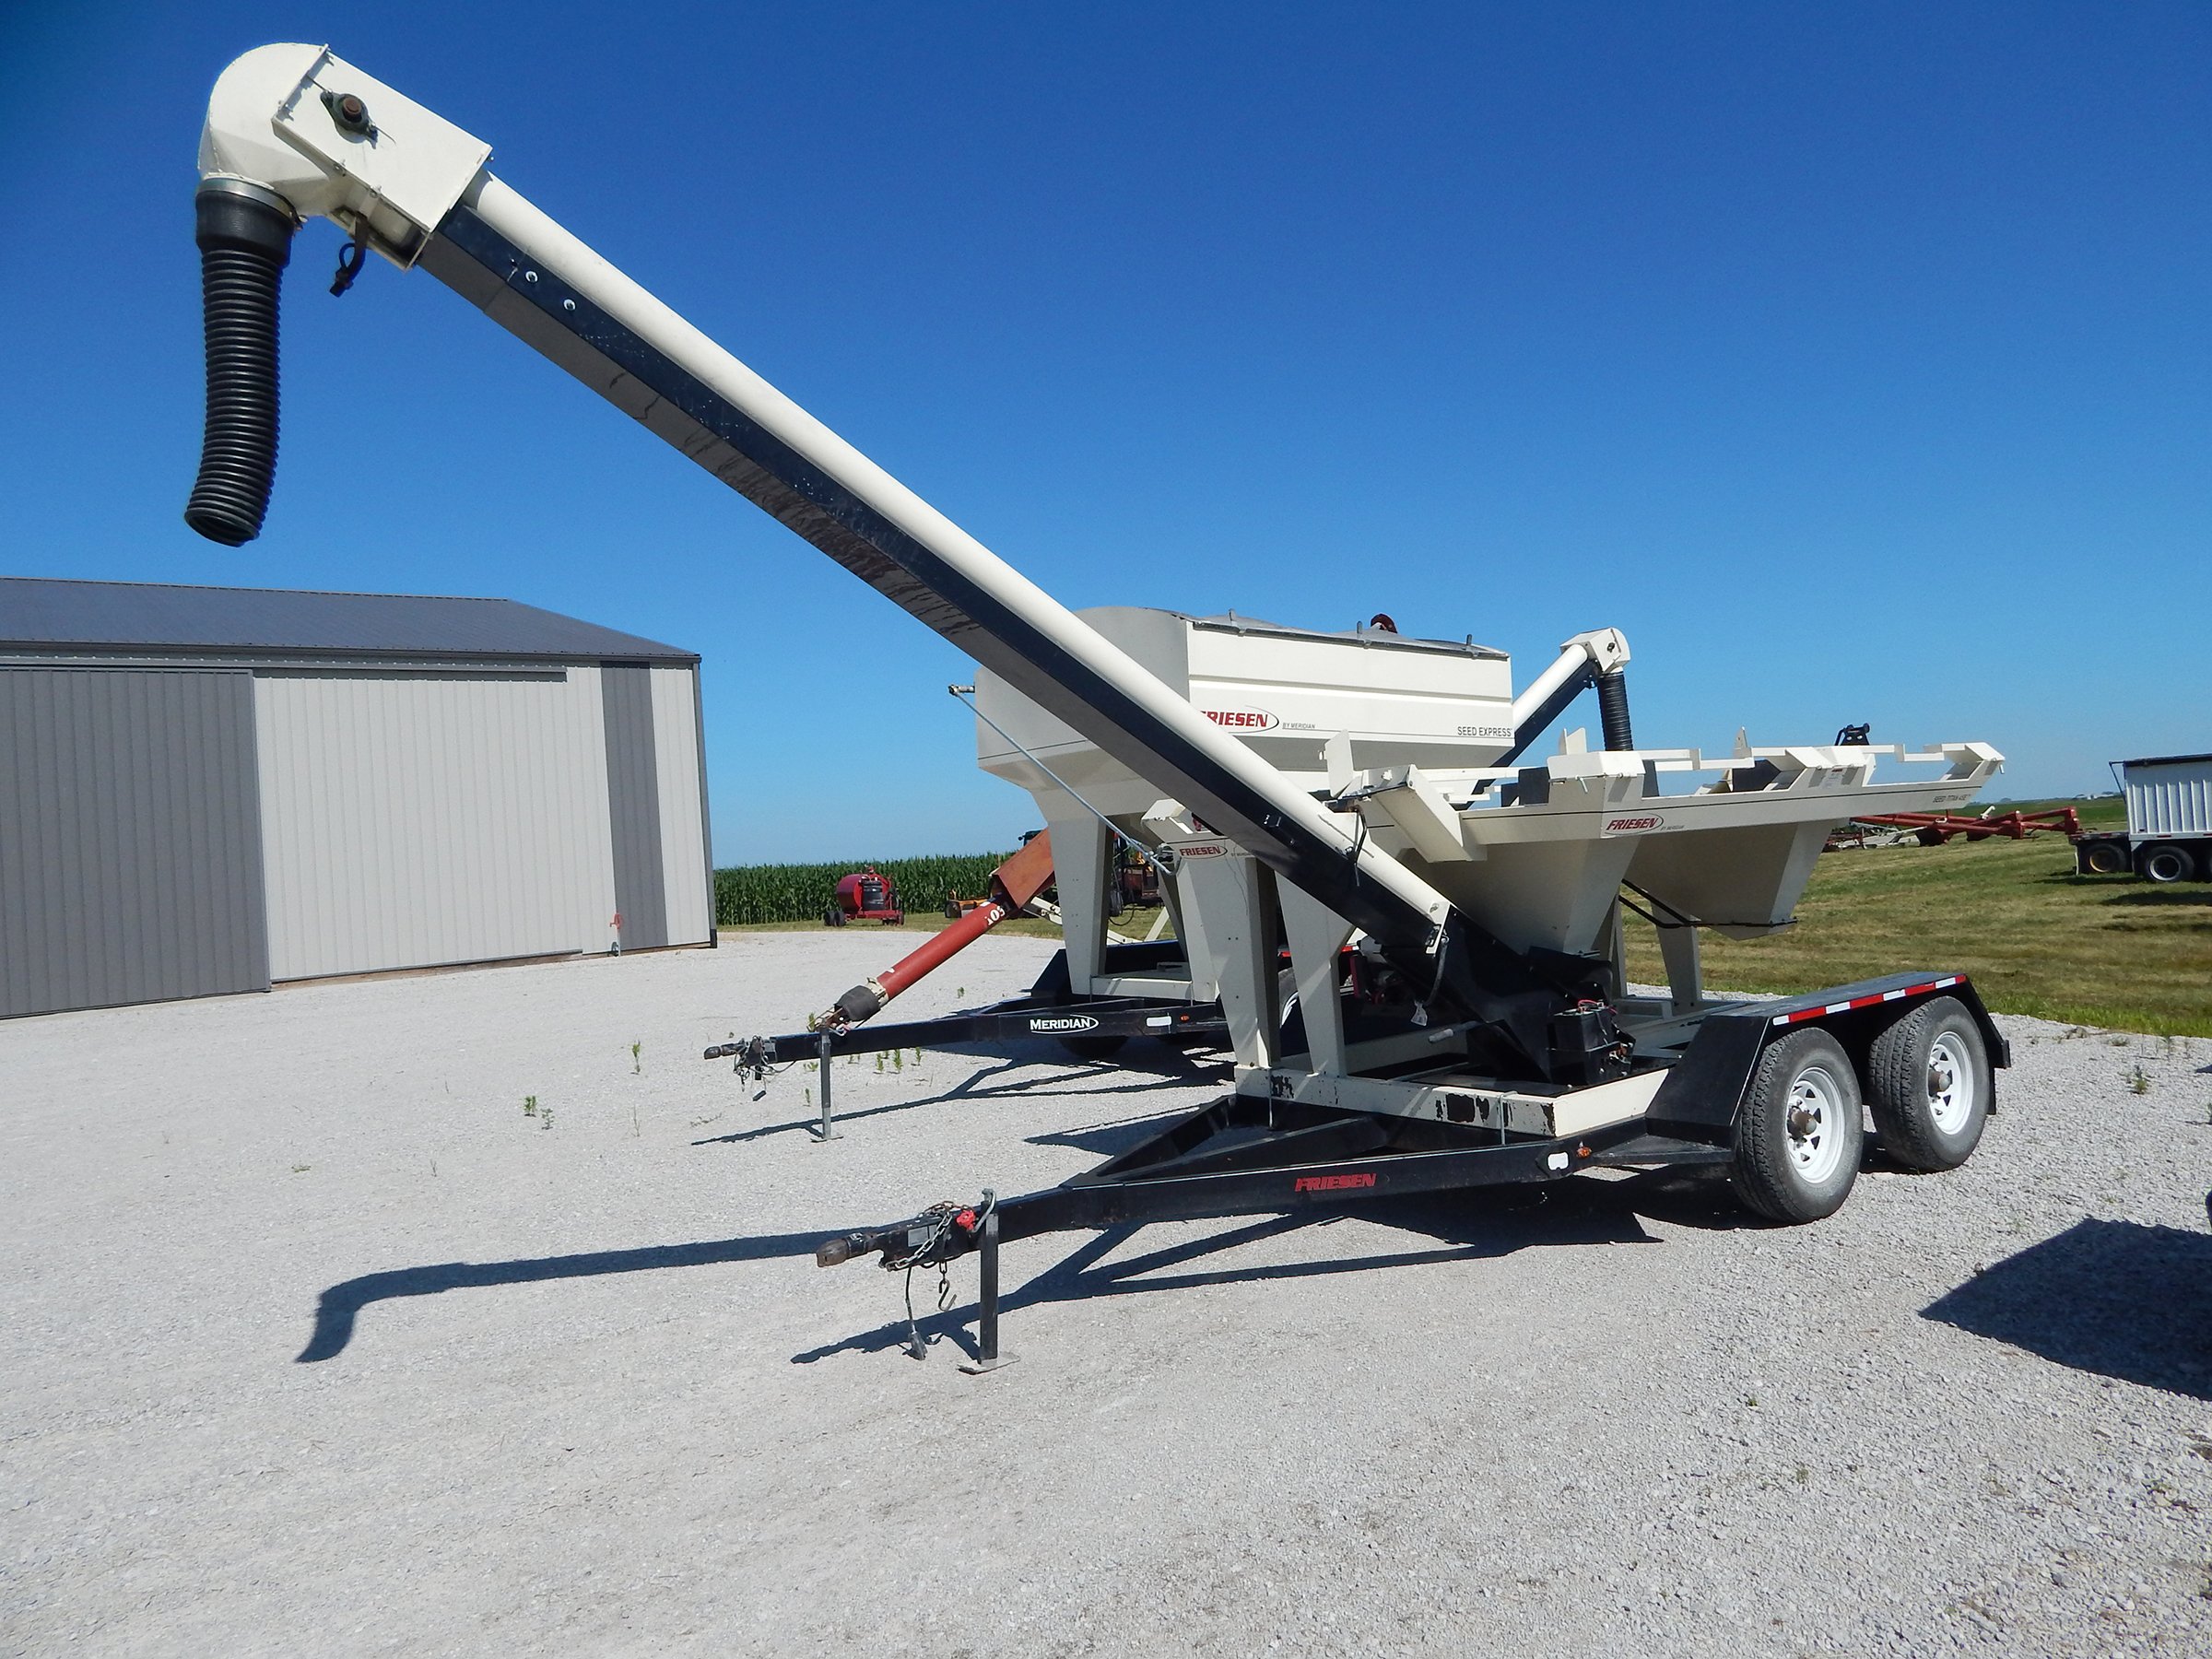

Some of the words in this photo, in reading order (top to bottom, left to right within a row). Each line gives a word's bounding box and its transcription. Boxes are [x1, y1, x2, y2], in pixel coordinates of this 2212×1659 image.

[1200, 711, 1268, 727] RIESEN
[1457, 726, 1477, 736] SEED
[1606, 818, 1658, 831] FRIESEN
[1180, 846, 1221, 856] FRIESEN
[1030, 1018, 1090, 1030] MERIDIAN
[1295, 1173, 1376, 1192] FRIESEN
